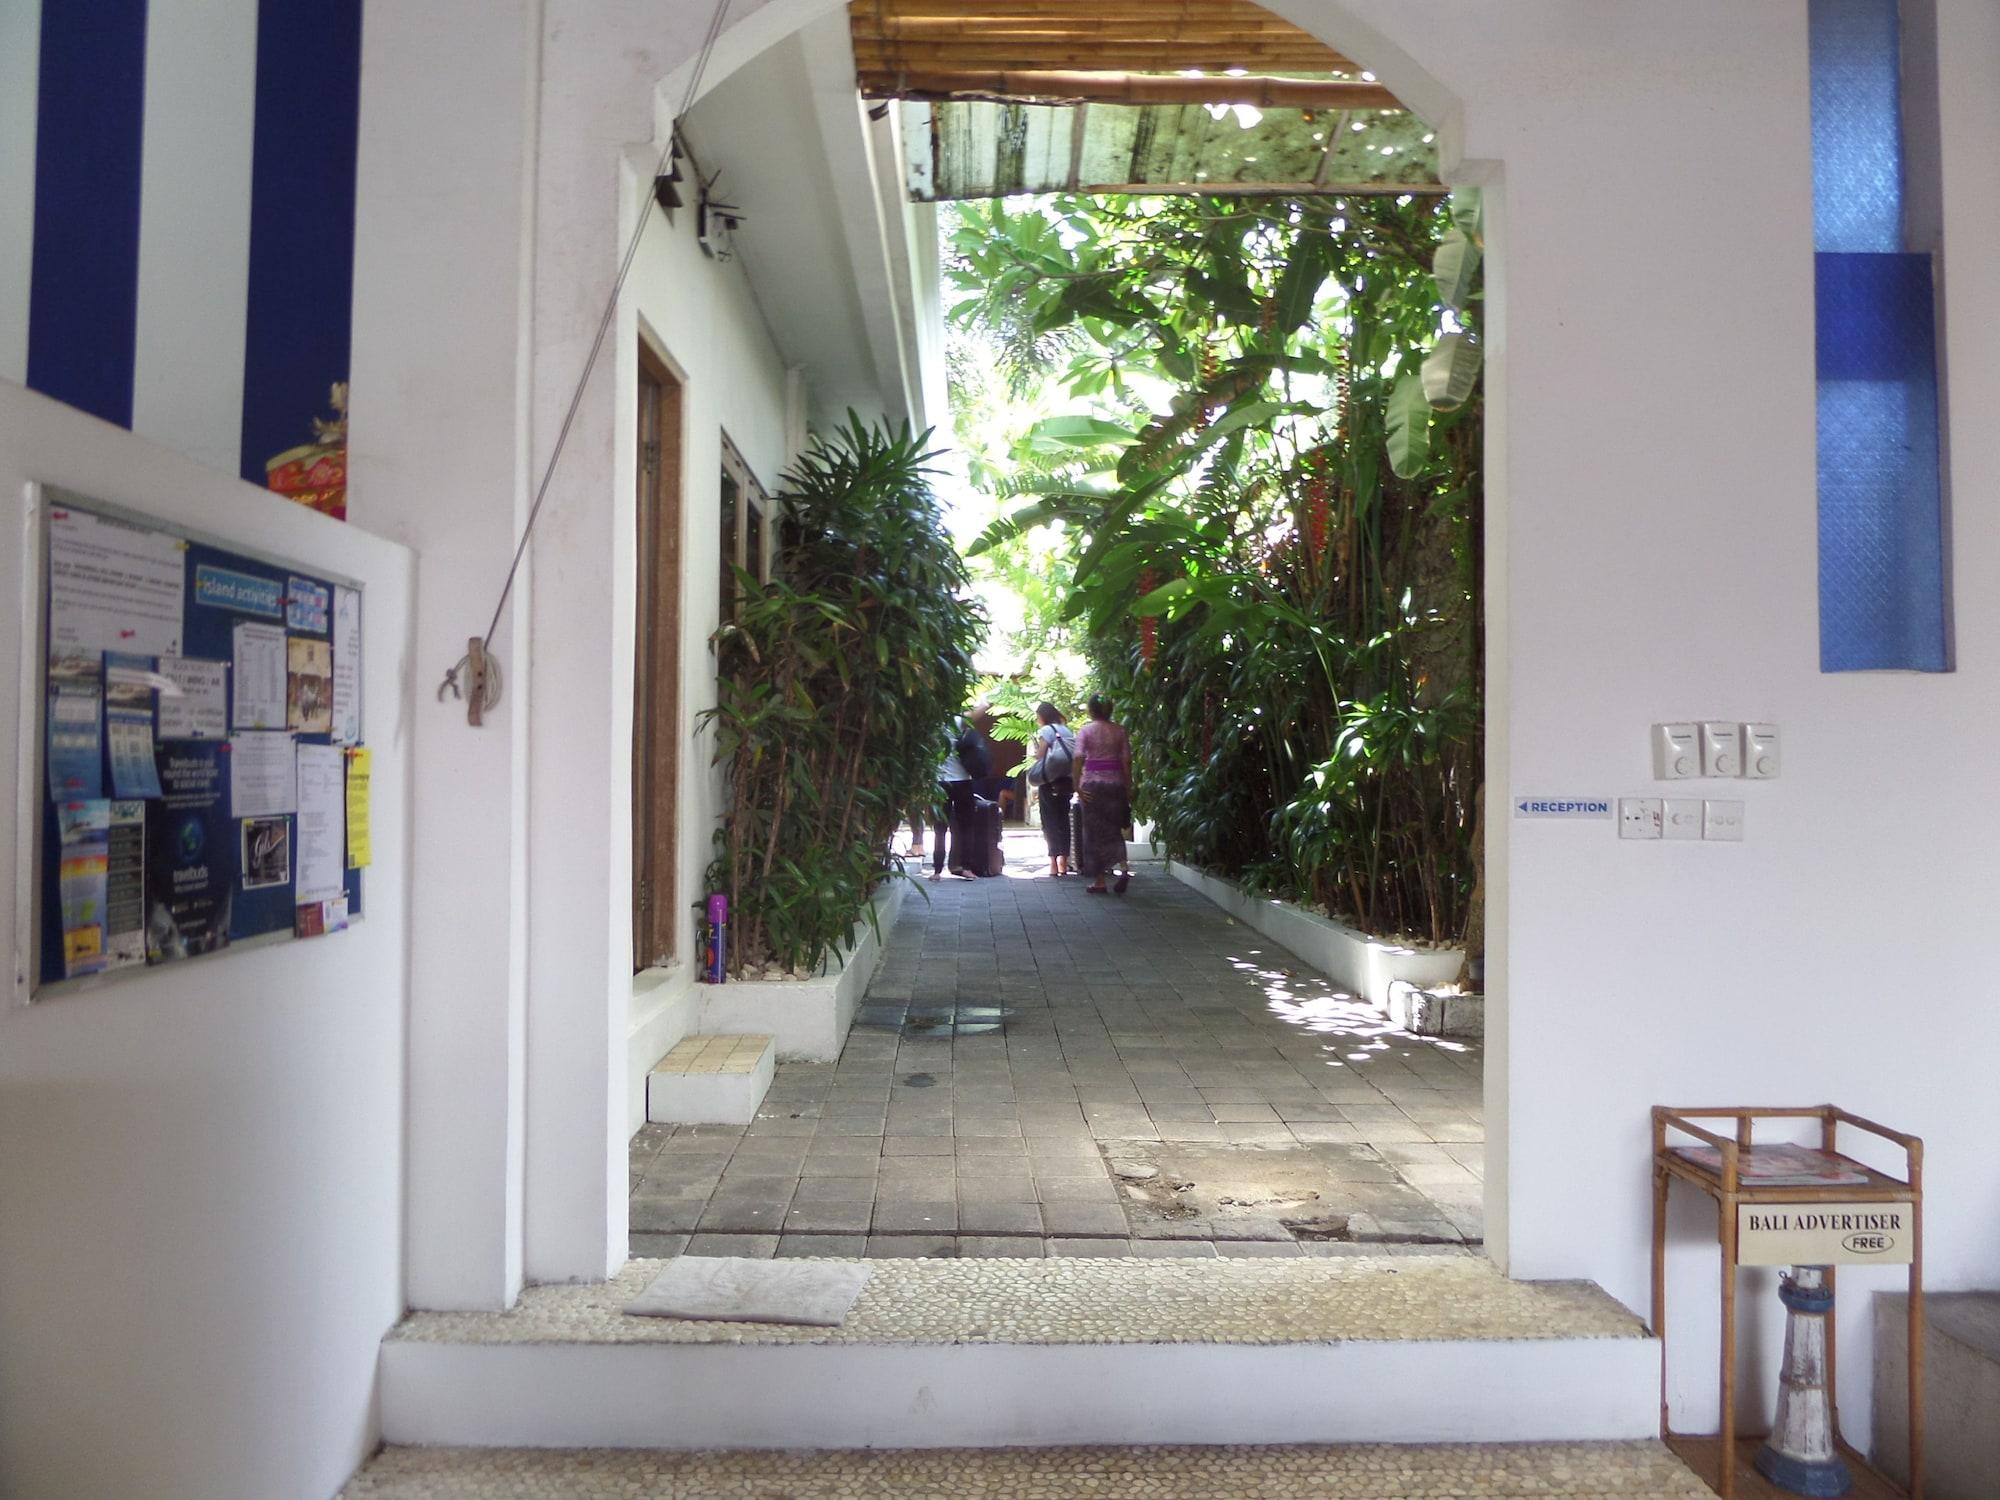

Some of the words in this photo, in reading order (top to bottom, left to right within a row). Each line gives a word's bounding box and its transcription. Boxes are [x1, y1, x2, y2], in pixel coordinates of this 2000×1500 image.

[1531, 802, 1608, 812] RECEPTION
[1750, 1215, 1789, 1231] BALI
[1793, 1214, 1901, 1231] ADVERTISER
[1852, 1236, 1885, 1249] FREE
